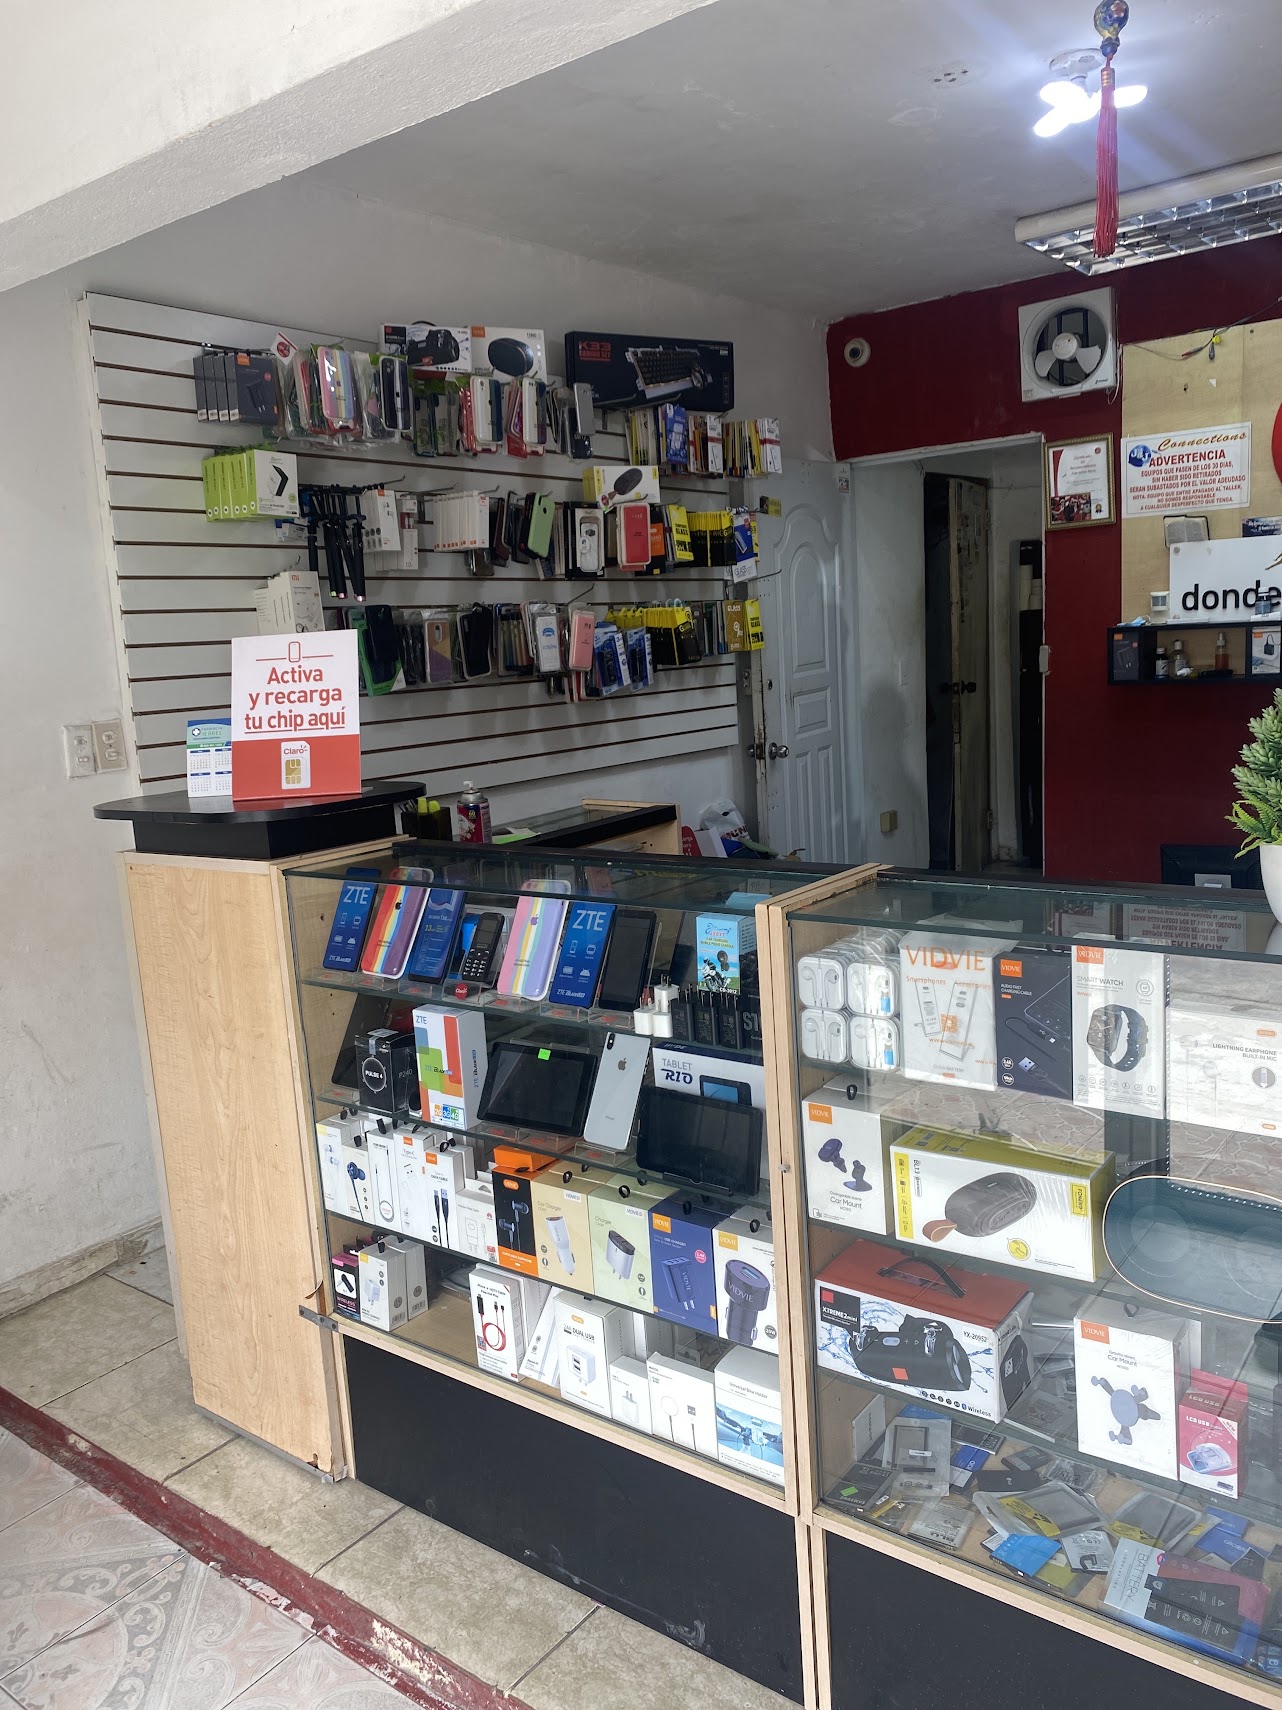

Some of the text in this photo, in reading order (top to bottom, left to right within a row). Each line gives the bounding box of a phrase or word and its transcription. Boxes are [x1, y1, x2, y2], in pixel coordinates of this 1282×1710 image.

[579, 341, 611, 350] K33
[1158, 432, 1246, 452] Connections
[1149, 449, 1226, 467] ADVERTENCIA
[1141, 467, 1162, 477] EQUIPOS
[1164, 466, 1174, 474] QUE
[1176, 465, 1191, 473] PASEN
[1193, 470, 1221, 478] RETIRADOS
[1147, 482, 1179, 492] SUBASTADOS
[1218, 475, 1245, 483] ADEUDADO
[1182, 493, 1215, 501] RESPONSABLE
[676, 528, 688, 536] GLASS
[734, 566, 746, 575] GLASS
[1182, 580, 1281, 611] donde
[267, 665, 323, 685] Activa
[249, 687, 342, 711] y recarga
[245, 705, 345, 732] tu chip aquí
[283, 745, 306, 755] Claro
[344, 886, 370, 904] ZTE
[573, 910, 606, 931] ZTE
[906, 945, 986, 971] VIDVIE
[906, 976, 946, 985] Smartphones
[1099, 978, 1123, 986] WATCH
[416, 1015, 427, 1024] ZTE
[1213, 1043, 1277, 1056] LIGHTNING EARPHONE
[1243, 1052, 1265, 1060] BUILT-IN
[662, 1059, 692, 1071] TABLET
[366, 1070, 379, 1079] PULSE
[399, 1069, 413, 1078] P240
[443, 1110, 450, 1118] 3G
[451, 1111, 458, 1119] 4G
[811, 1109, 829, 1118] VIDVIE
[545, 1203, 561, 1211] Charger
[842, 1199, 862, 1209] Mount
[595, 1216, 611, 1225] Charger
[654, 1219, 669, 1228] VIDVIE
[720, 1237, 736, 1245] VIDVIE
[728, 1281, 754, 1302] VIDVIE
[572, 1327, 585, 1338] DUAL
[585, 1332, 595, 1341] USB
[1084, 1327, 1105, 1337] VIDVIE
[1119, 1356, 1138, 1367] Mount
[729, 1381, 746, 1391] Universal
[755, 1391, 768, 1399] Holder
[968, 1406, 992, 1417] Wireless
[1126, 1552, 1149, 1602] BATTERY
